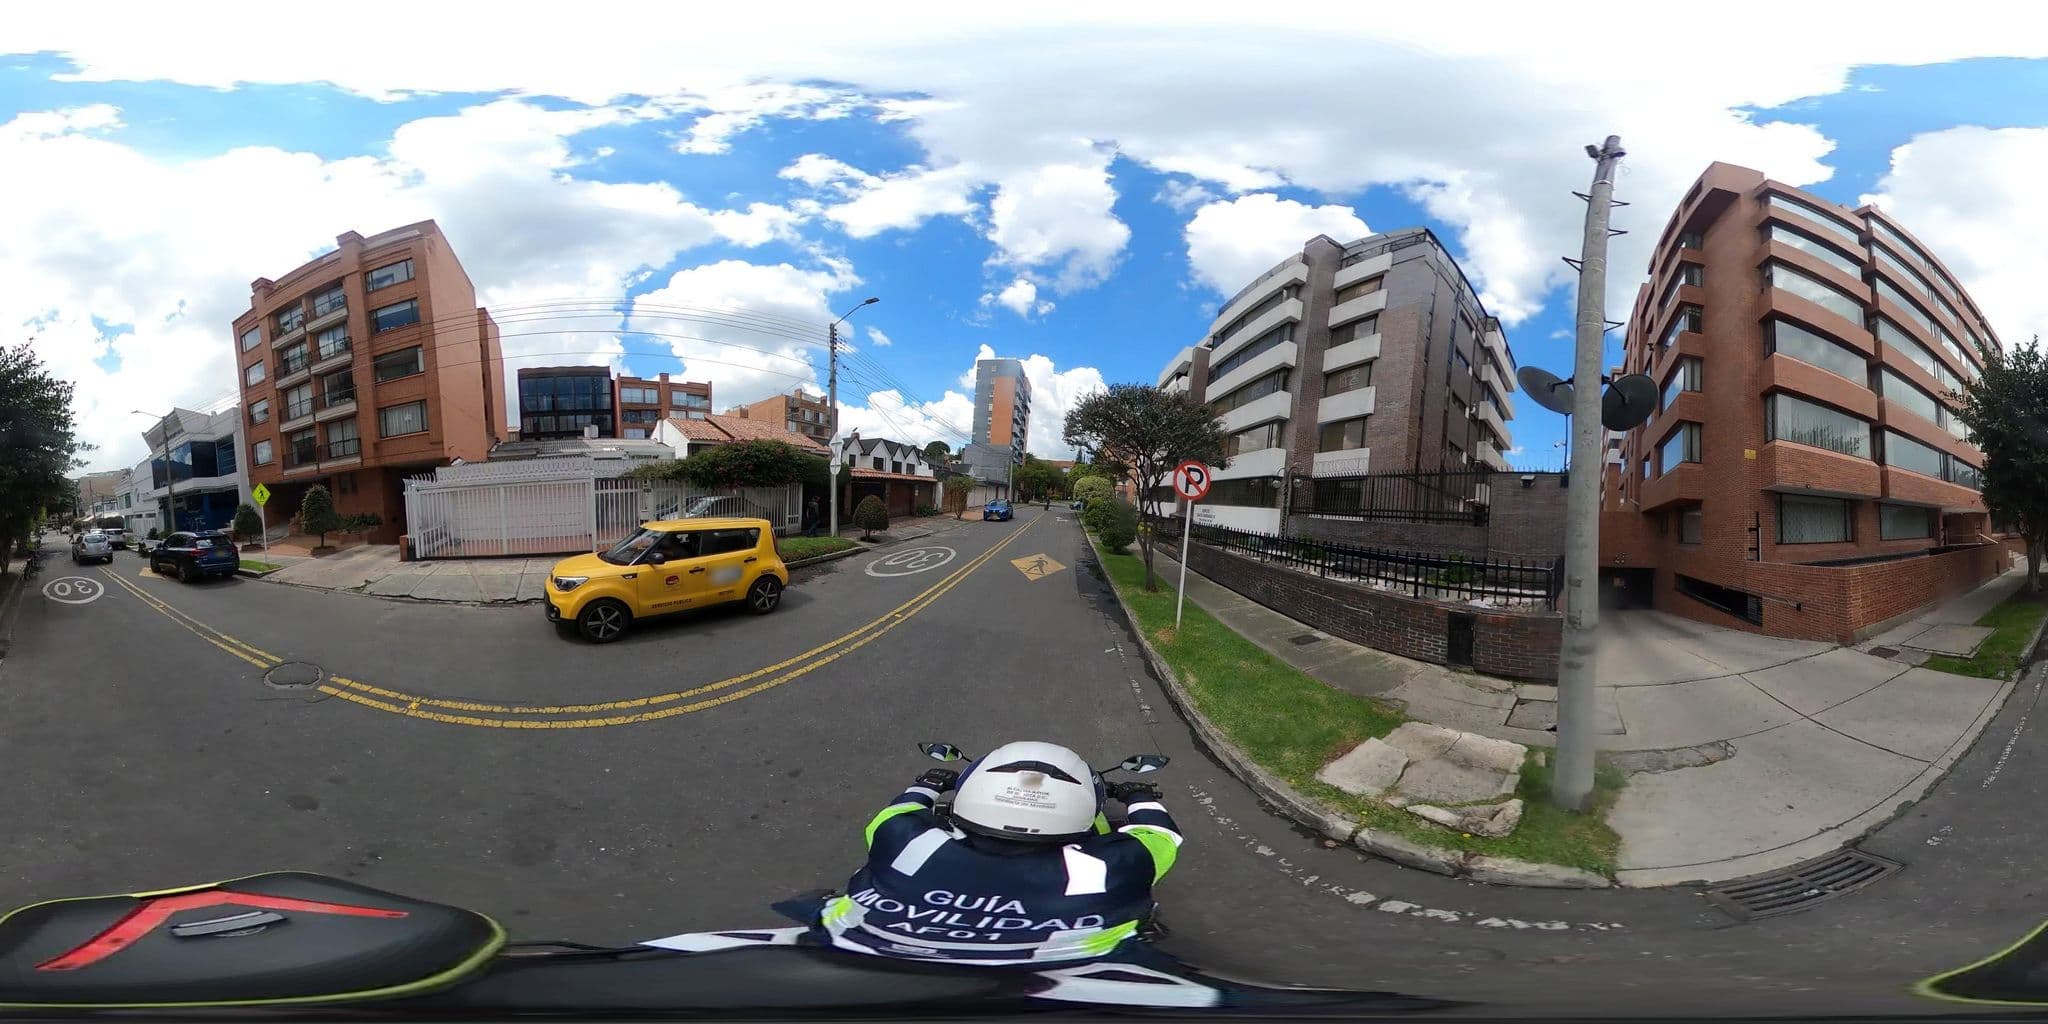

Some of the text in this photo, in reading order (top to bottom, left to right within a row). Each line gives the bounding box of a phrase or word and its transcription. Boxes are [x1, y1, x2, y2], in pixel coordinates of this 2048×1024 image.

[1185, 467, 1204, 493] P
[884, 551, 944, 569] 30
[54, 580, 92, 596] 30
[852, 888, 1105, 930] MOVILIDAD
[924, 890, 1026, 915] GUÍA
